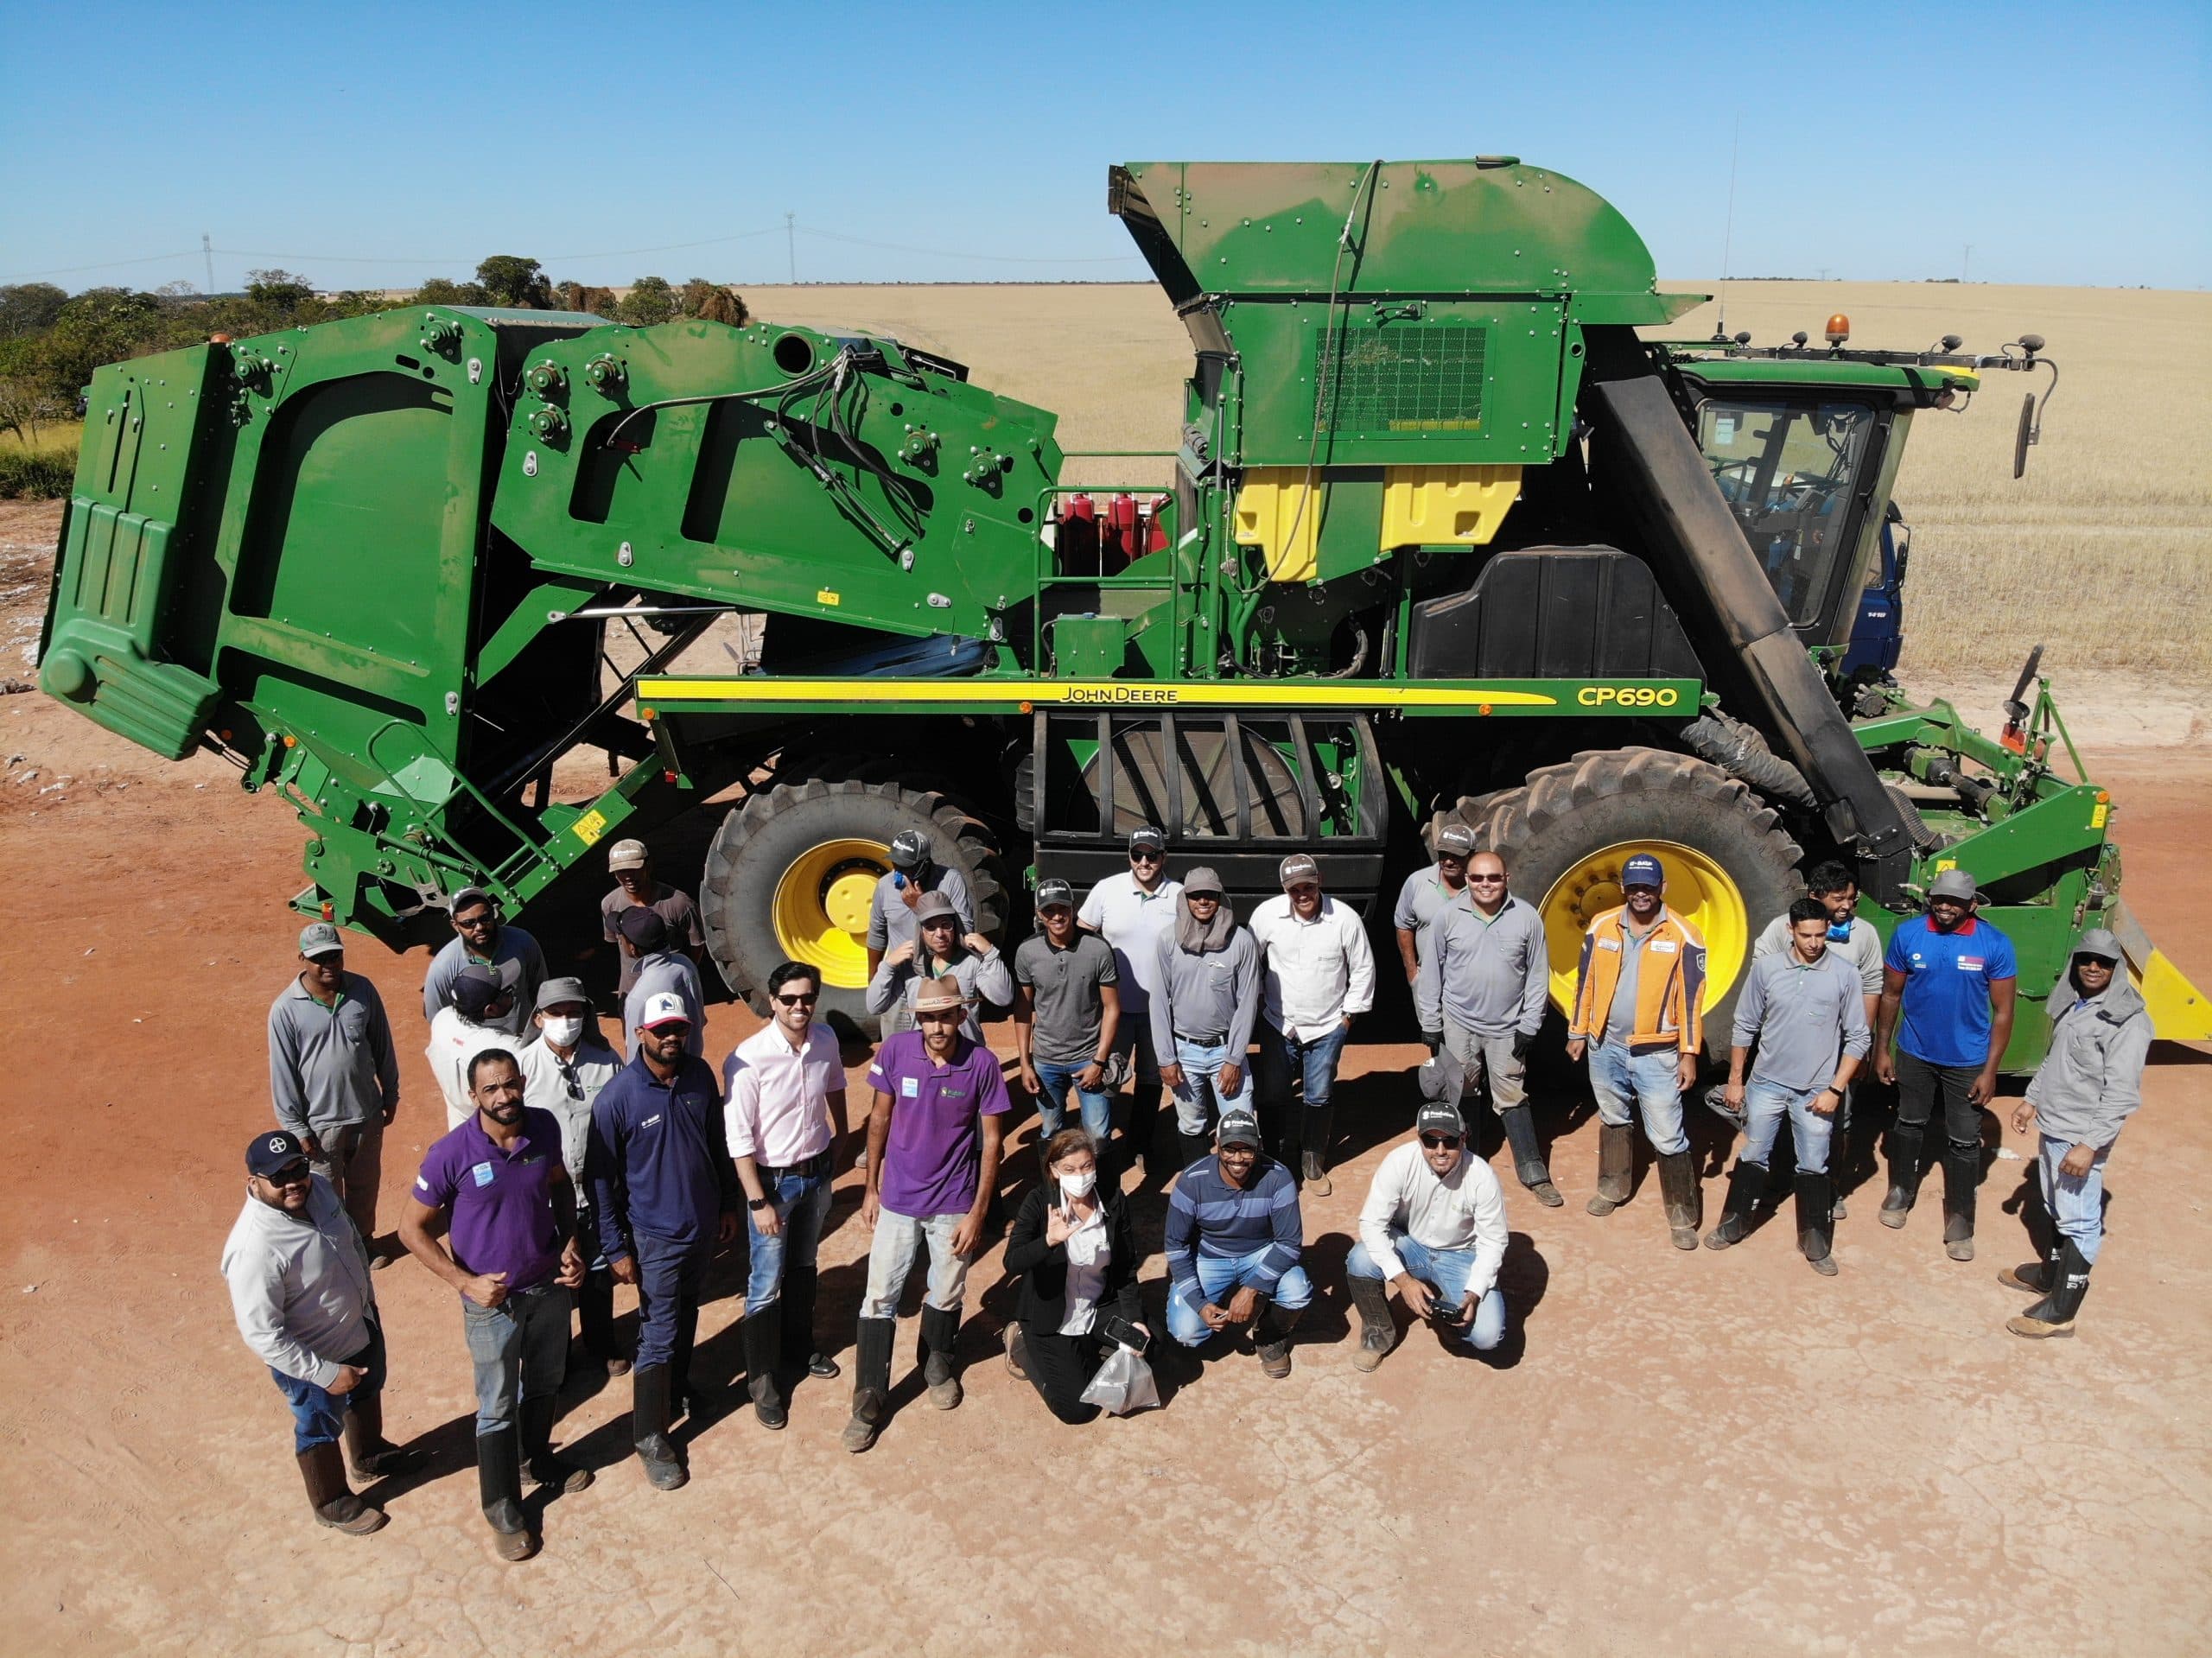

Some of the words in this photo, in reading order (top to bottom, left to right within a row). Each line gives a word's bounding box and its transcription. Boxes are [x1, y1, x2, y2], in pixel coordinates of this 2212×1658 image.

[1063, 686, 1112, 701] JOHN
[1116, 687, 1178, 702] DEERE
[1577, 687, 1679, 707] CP690
